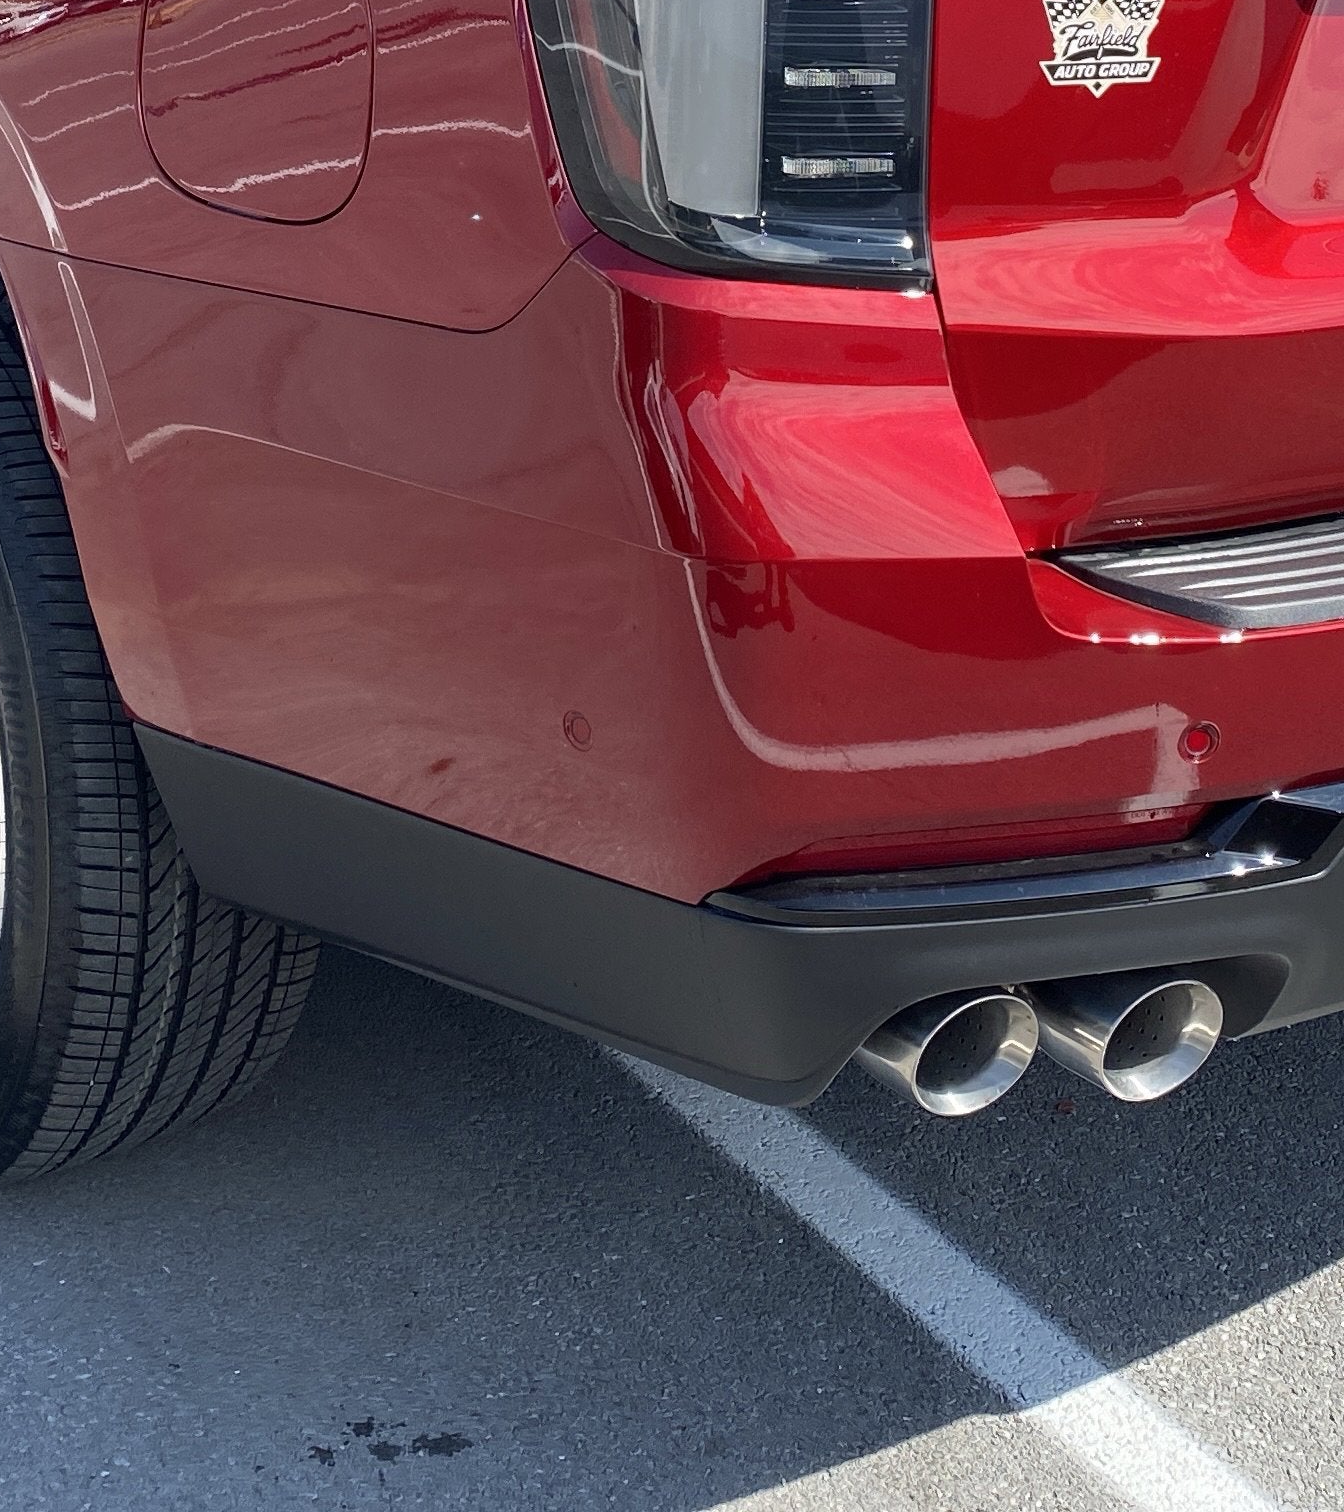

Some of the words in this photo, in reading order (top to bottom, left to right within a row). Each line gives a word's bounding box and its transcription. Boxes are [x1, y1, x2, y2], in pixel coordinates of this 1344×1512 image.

[1059, 20, 1147, 59] Fairfield
[1054, 65, 1097, 79] AUTO
[1098, 63, 1150, 77] GROUP
